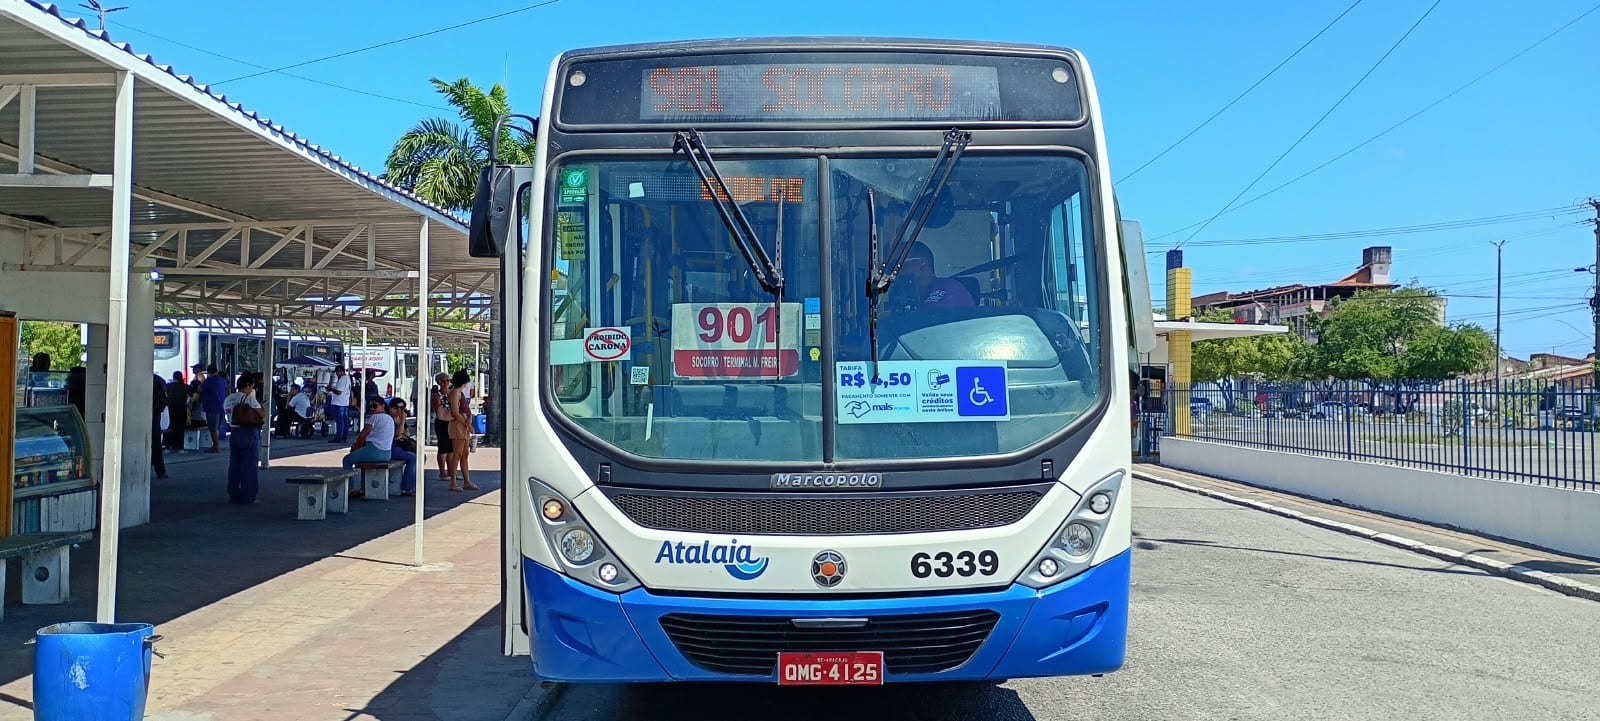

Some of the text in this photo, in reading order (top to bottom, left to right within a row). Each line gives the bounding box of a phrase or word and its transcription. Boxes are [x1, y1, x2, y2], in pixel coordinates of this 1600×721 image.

[762, 67, 951, 111] SOCORRO
[698, 306, 776, 343] 901
[589, 333, 627, 341] PROIBIDO
[588, 342, 627, 351] CARONA
[691, 356, 719, 368] SOCORRO
[723, 356, 752, 368] TERMINAL
[761, 356, 780, 369] FREIR
[841, 371, 865, 389] R$
[872, 402, 894, 411] mais
[776, 473, 879, 488] Marcopolo
[655, 538, 760, 565] Atalaia
[910, 550, 999, 579] 6339
